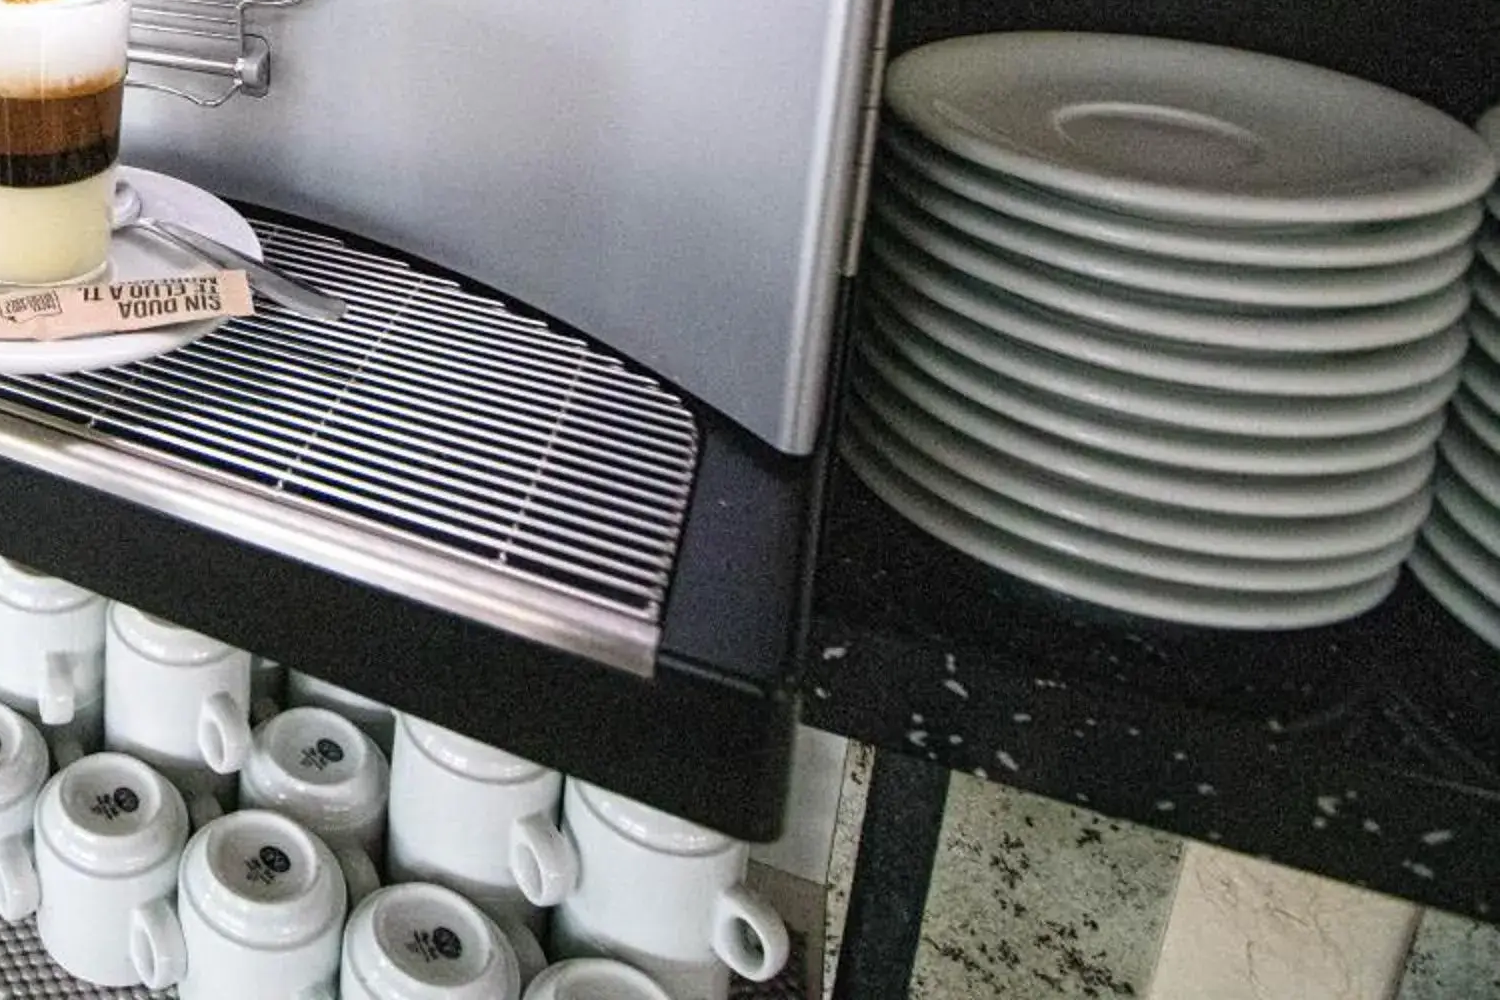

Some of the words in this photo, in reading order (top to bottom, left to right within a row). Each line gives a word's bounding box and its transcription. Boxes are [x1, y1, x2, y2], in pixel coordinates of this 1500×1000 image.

[109, 285, 123, 299] A
[194, 284, 218, 295] TE
[119, 296, 178, 319] DUDA
[186, 294, 222, 312] SIN
